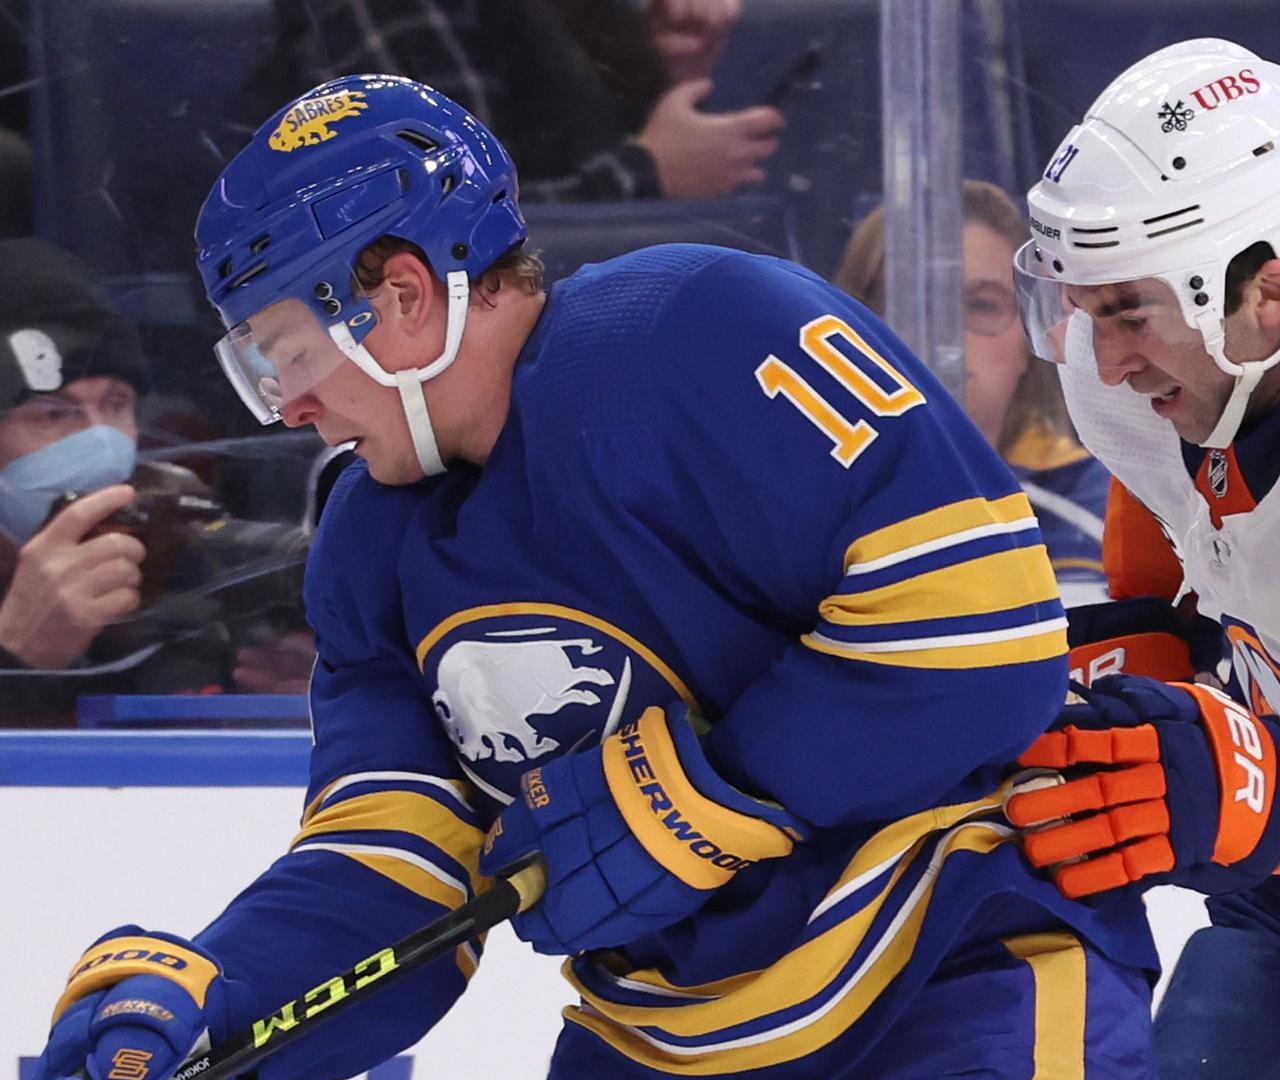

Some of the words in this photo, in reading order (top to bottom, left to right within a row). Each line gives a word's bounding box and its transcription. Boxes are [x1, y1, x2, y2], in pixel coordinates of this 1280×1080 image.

[285, 96, 345, 132] SABRES
[1190, 69, 1261, 111] UBS
[754, 314, 926, 469] 10
[252, 946, 401, 1049] CCM
